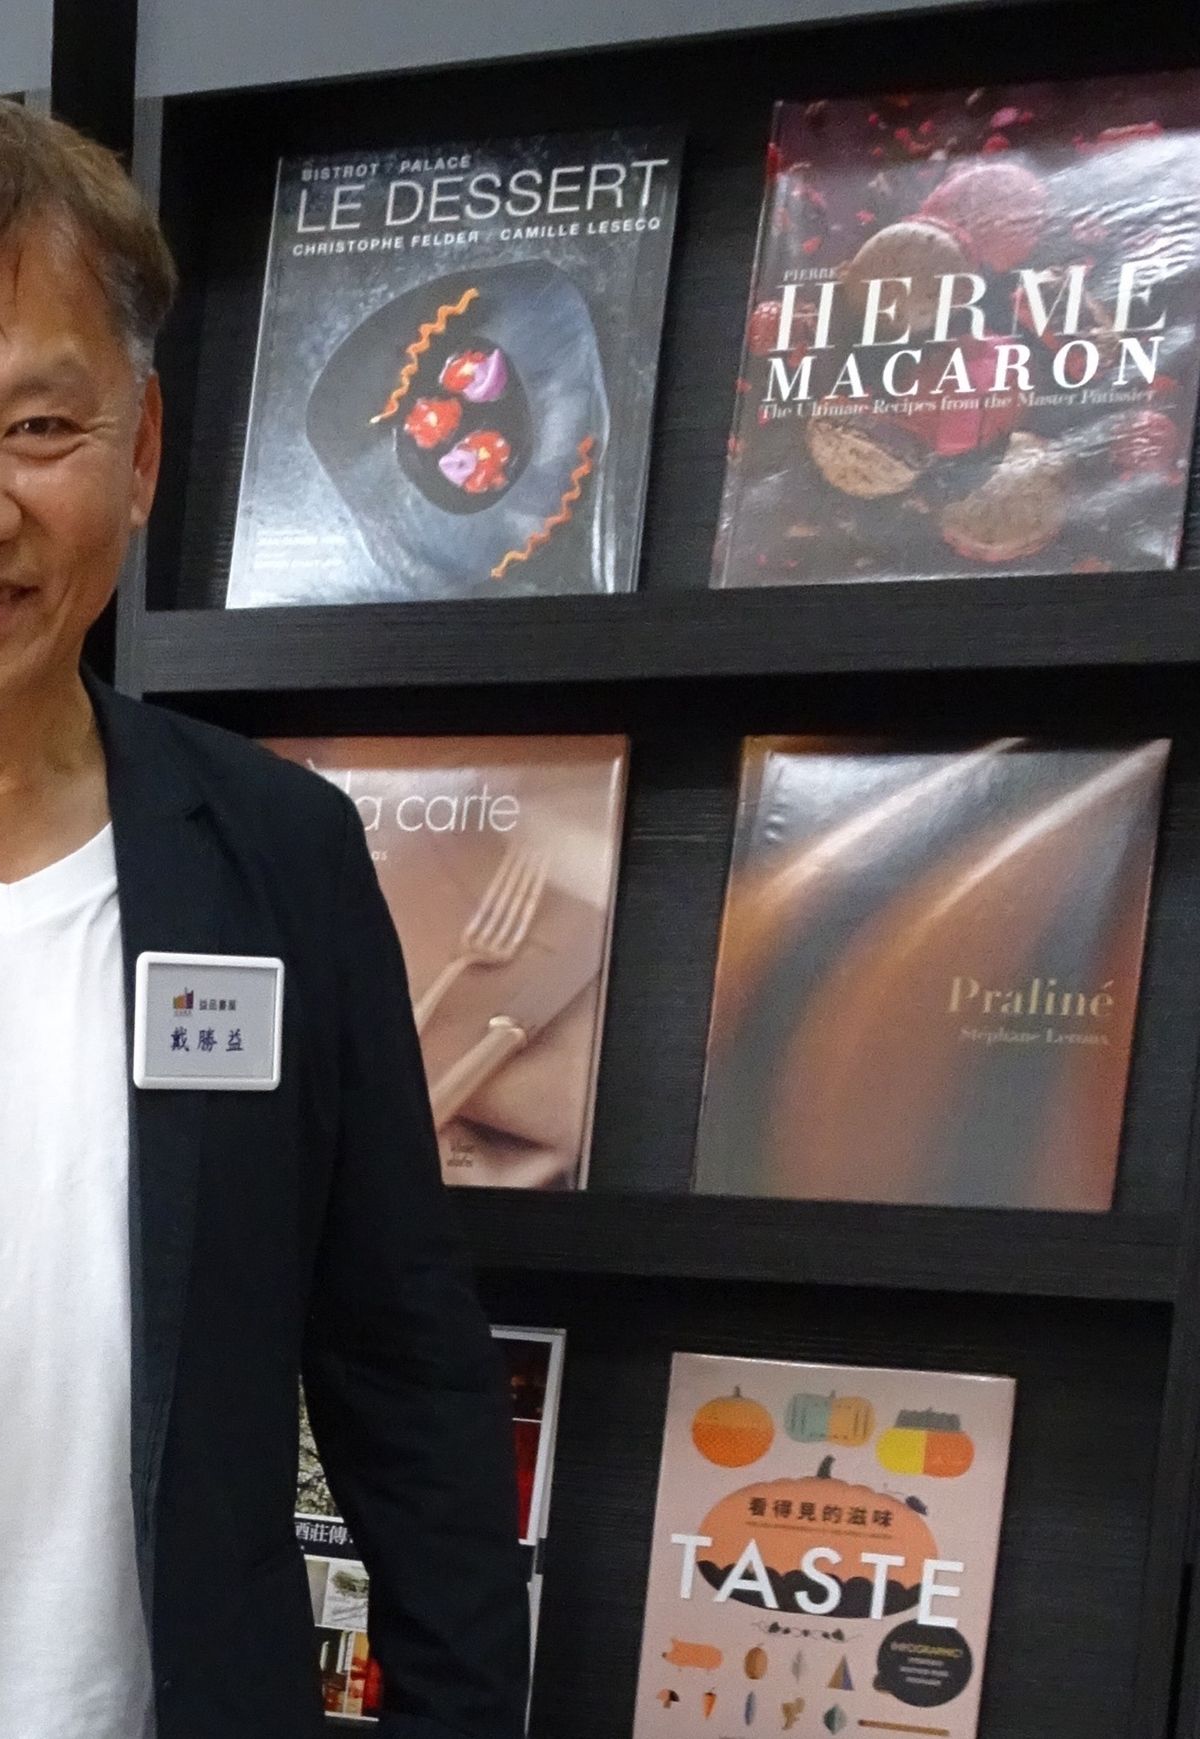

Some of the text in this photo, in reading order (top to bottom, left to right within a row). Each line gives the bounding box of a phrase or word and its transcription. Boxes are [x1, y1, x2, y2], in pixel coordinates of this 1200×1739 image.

[302, 155, 472, 181] BISTROT PALACE
[297, 158, 670, 233] LE DESSERT
[292, 236, 404, 257] CHRISTOPHE
[411, 230, 480, 247] FELDER
[500, 223, 581, 241] CAMILLE
[761, 336, 1165, 402] MACARON
[762, 402, 793, 419] The
[796, 402, 871, 418] Ultimate
[873, 398, 938, 416] Recipes
[939, 394, 980, 412] from
[984, 392, 1013, 408] the
[396, 784, 520, 832] carte
[948, 977, 1115, 1016] Praliné
[170, 1026, 244, 1052] 戴勝益
[749, 1497, 893, 1527] 看得見的滋味
[670, 1533, 964, 1628] TASTE
